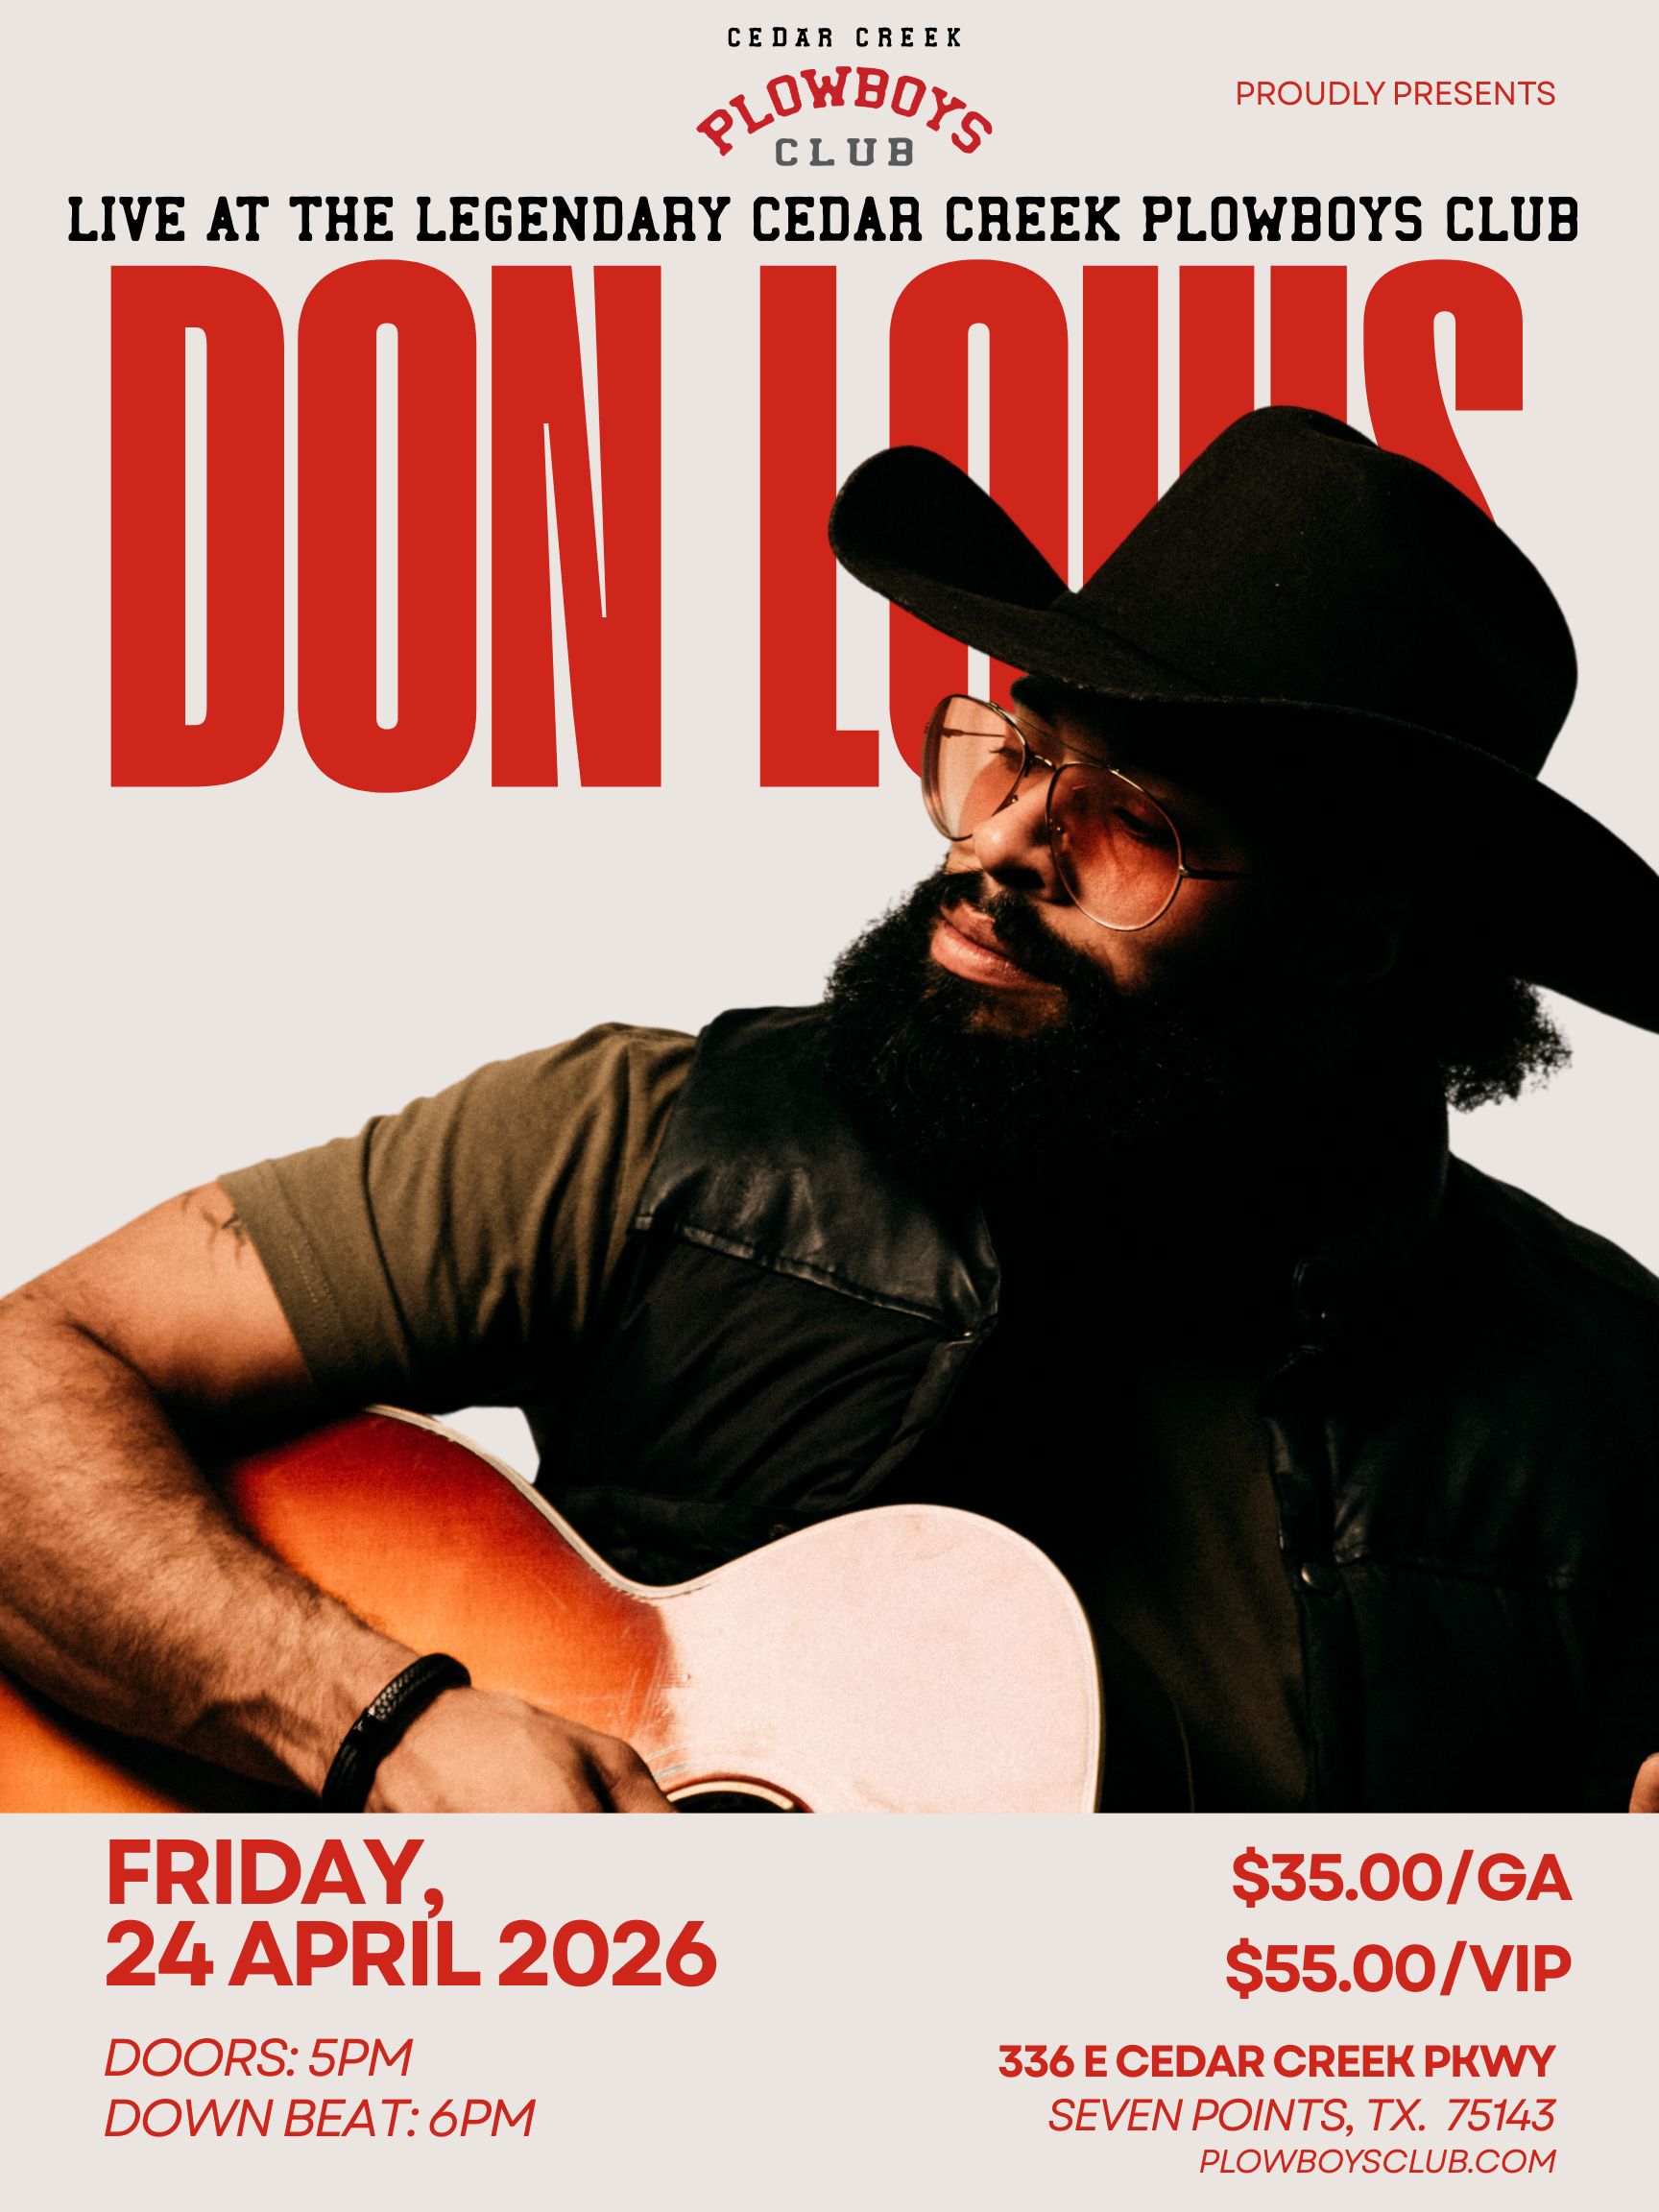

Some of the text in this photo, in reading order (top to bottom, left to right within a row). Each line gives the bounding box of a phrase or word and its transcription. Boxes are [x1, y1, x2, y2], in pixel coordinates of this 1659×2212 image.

[728, 27, 960, 47] CEDAR CREEK
[696, 66, 992, 156] PLOWBOYS
[1238, 81, 1555, 106] PROUDLY PRESENTS
[776, 137, 912, 166] CLUB
[68, 196, 1577, 241] LIVE AT THE LEGENDARY CEDAR CREEK PLOWBOYS CLUB
[110, 259, 661, 793] DON
[109, 1839, 444, 1918] FRIDAY,
[1233, 1846, 1573, 1908] $35.00/GA
[107, 1920, 716, 1987] 24 APRIL 2026
[1226, 1937, 1572, 1999] $55.00/VIP
[105, 2038, 413, 2077] DOORS: 5PM
[998, 2045, 1556, 2078] 336 E CEDAR CREEK PKWY
[105, 2099, 536, 2137] DOWN BEAT: 6PM
[1049, 2099, 1556, 2137] SEVEN POINTS, TX. 75143
[1200, 2149, 1556, 2174] PLOWBOYSCLUB.COM
